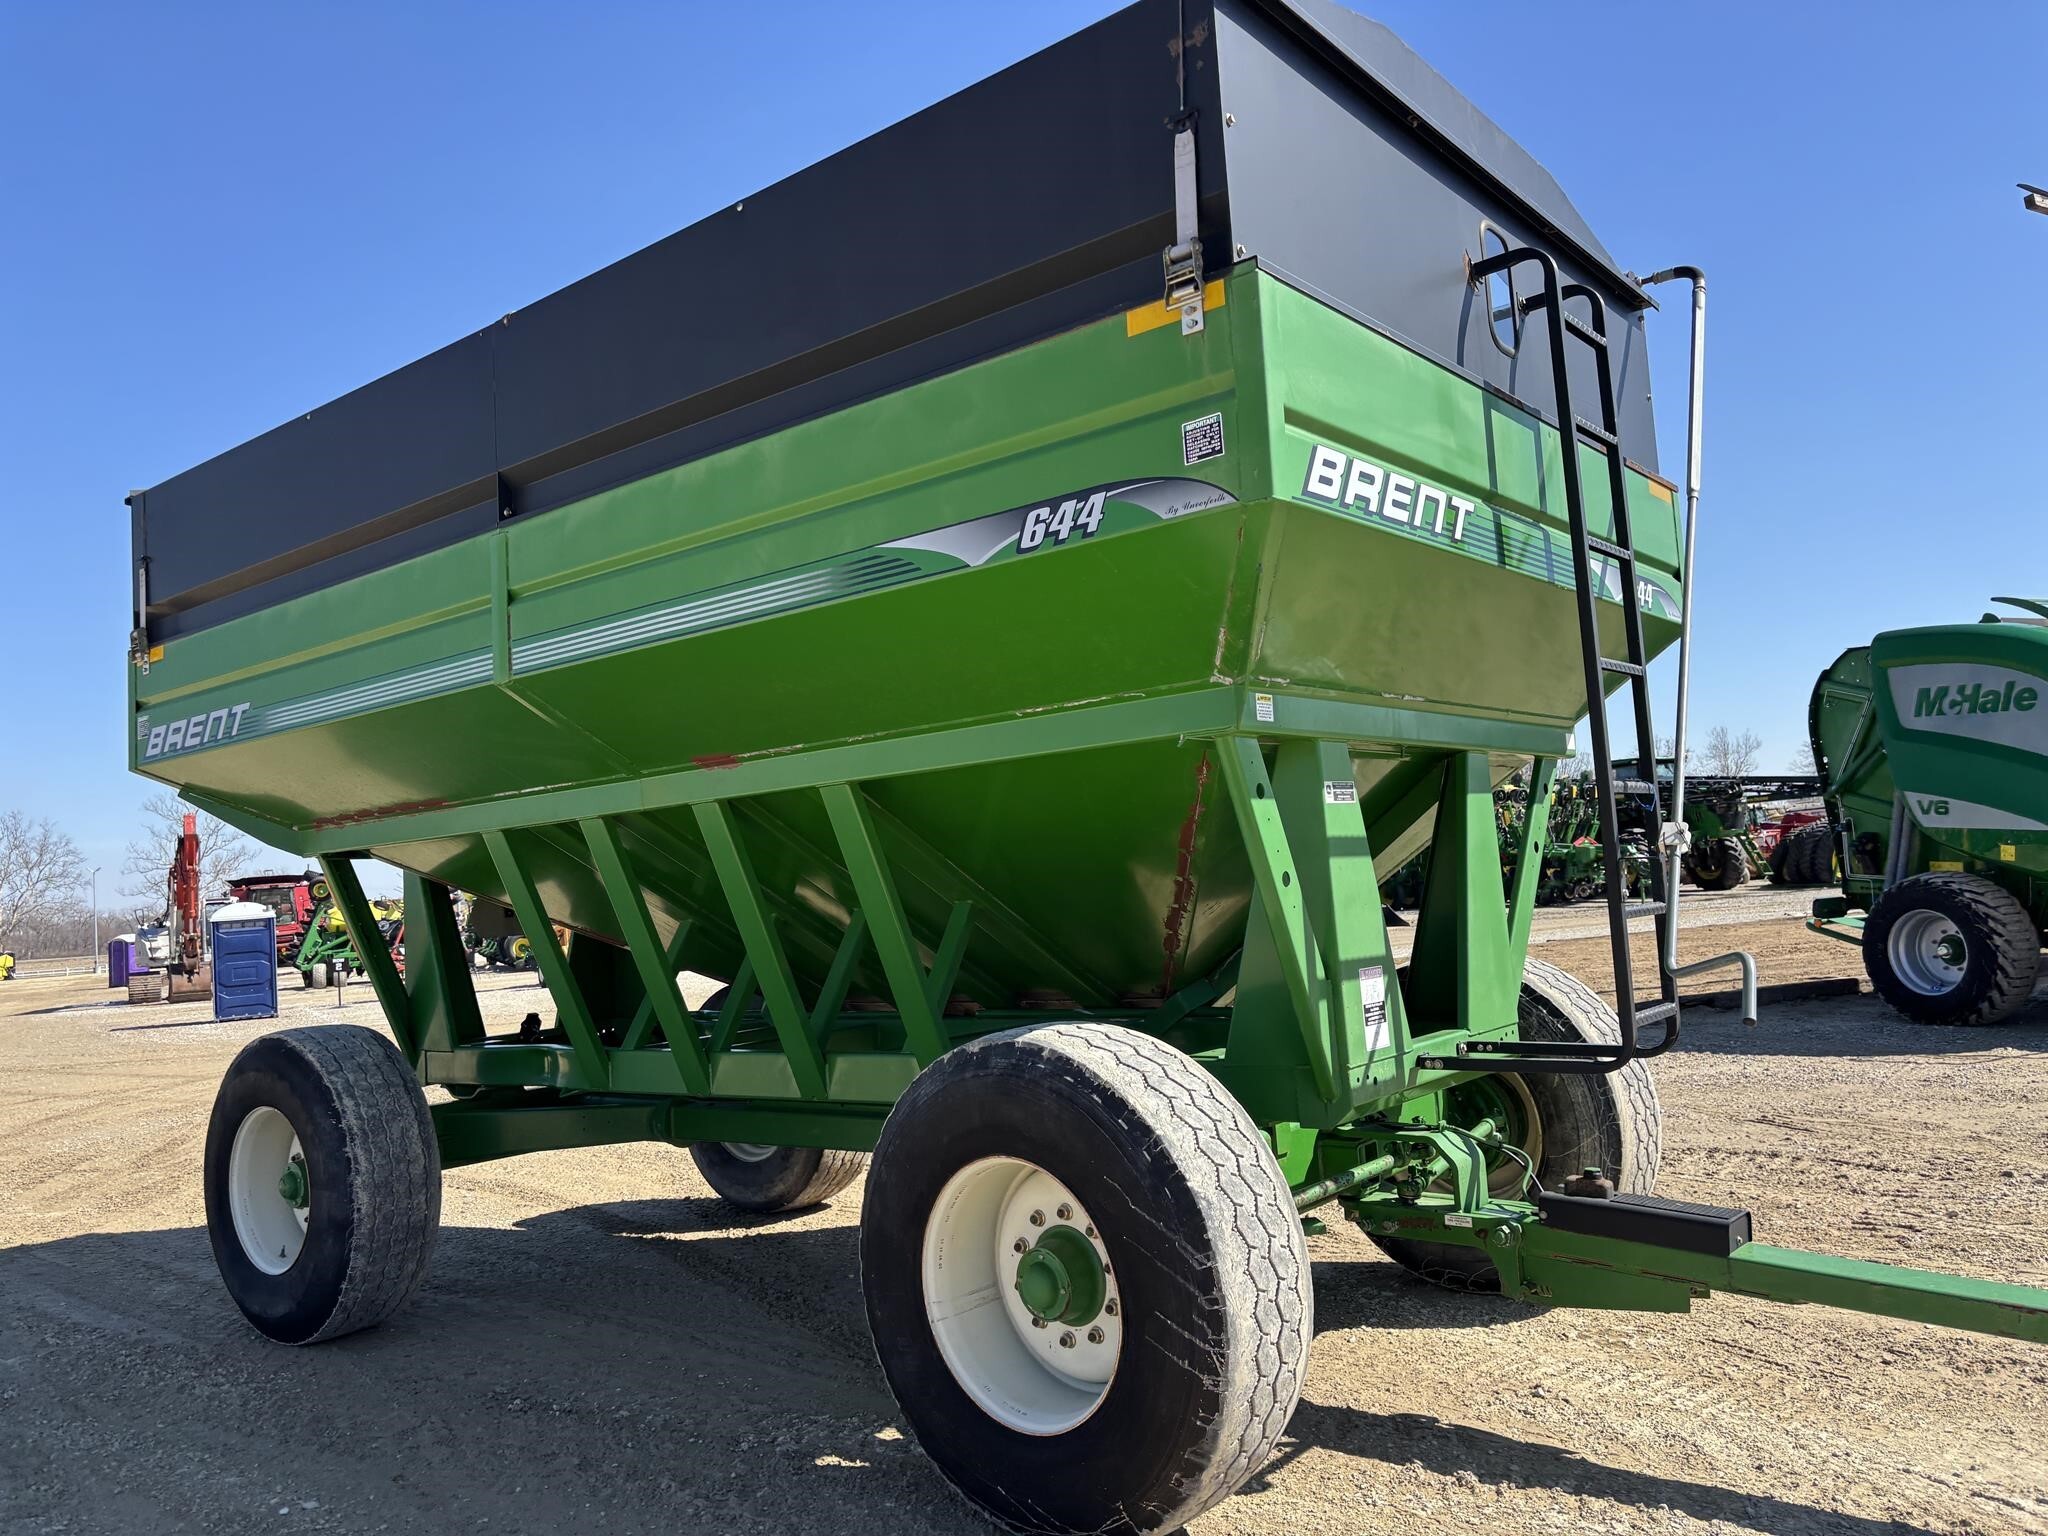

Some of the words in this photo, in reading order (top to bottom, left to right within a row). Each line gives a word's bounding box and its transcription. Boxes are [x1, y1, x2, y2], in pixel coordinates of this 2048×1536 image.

[1185, 416, 1217, 431] IMPORTANT
[1304, 444, 1476, 541] BRENT
[1019, 491, 1107, 550] 644
[1165, 505, 1179, 515] By
[1637, 581, 1653, 609] 44
[1914, 680, 2039, 718] McHale
[145, 702, 251, 757] BRENT
[1916, 799, 1950, 816] V6
